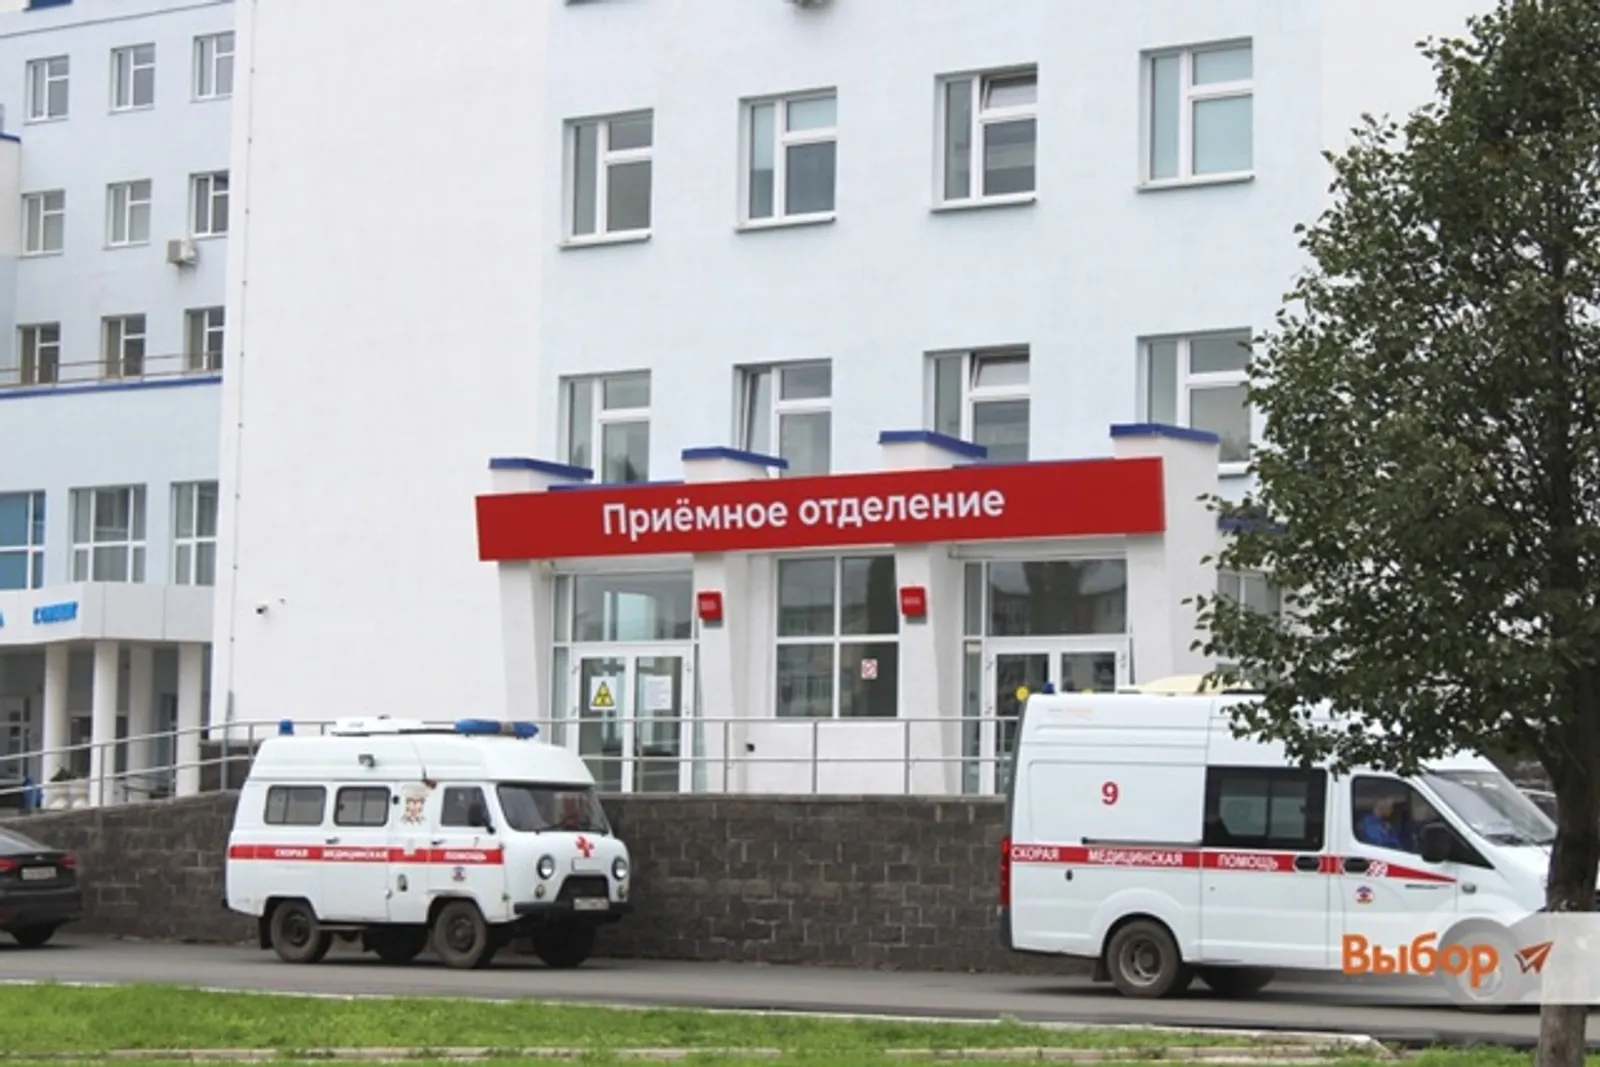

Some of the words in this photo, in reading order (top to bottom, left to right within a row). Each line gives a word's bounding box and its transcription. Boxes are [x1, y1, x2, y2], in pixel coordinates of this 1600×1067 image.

[602, 498, 788, 541] Приёмное
[798, 489, 1005, 528] отделение
[1101, 780, 1119, 806] 9
[1011, 848, 1059, 860] СКОРАЯ
[1088, 849, 1183, 866] МЕДИЦИНСКАЯ
[1217, 853, 1279, 871] ПОМОЩЬ
